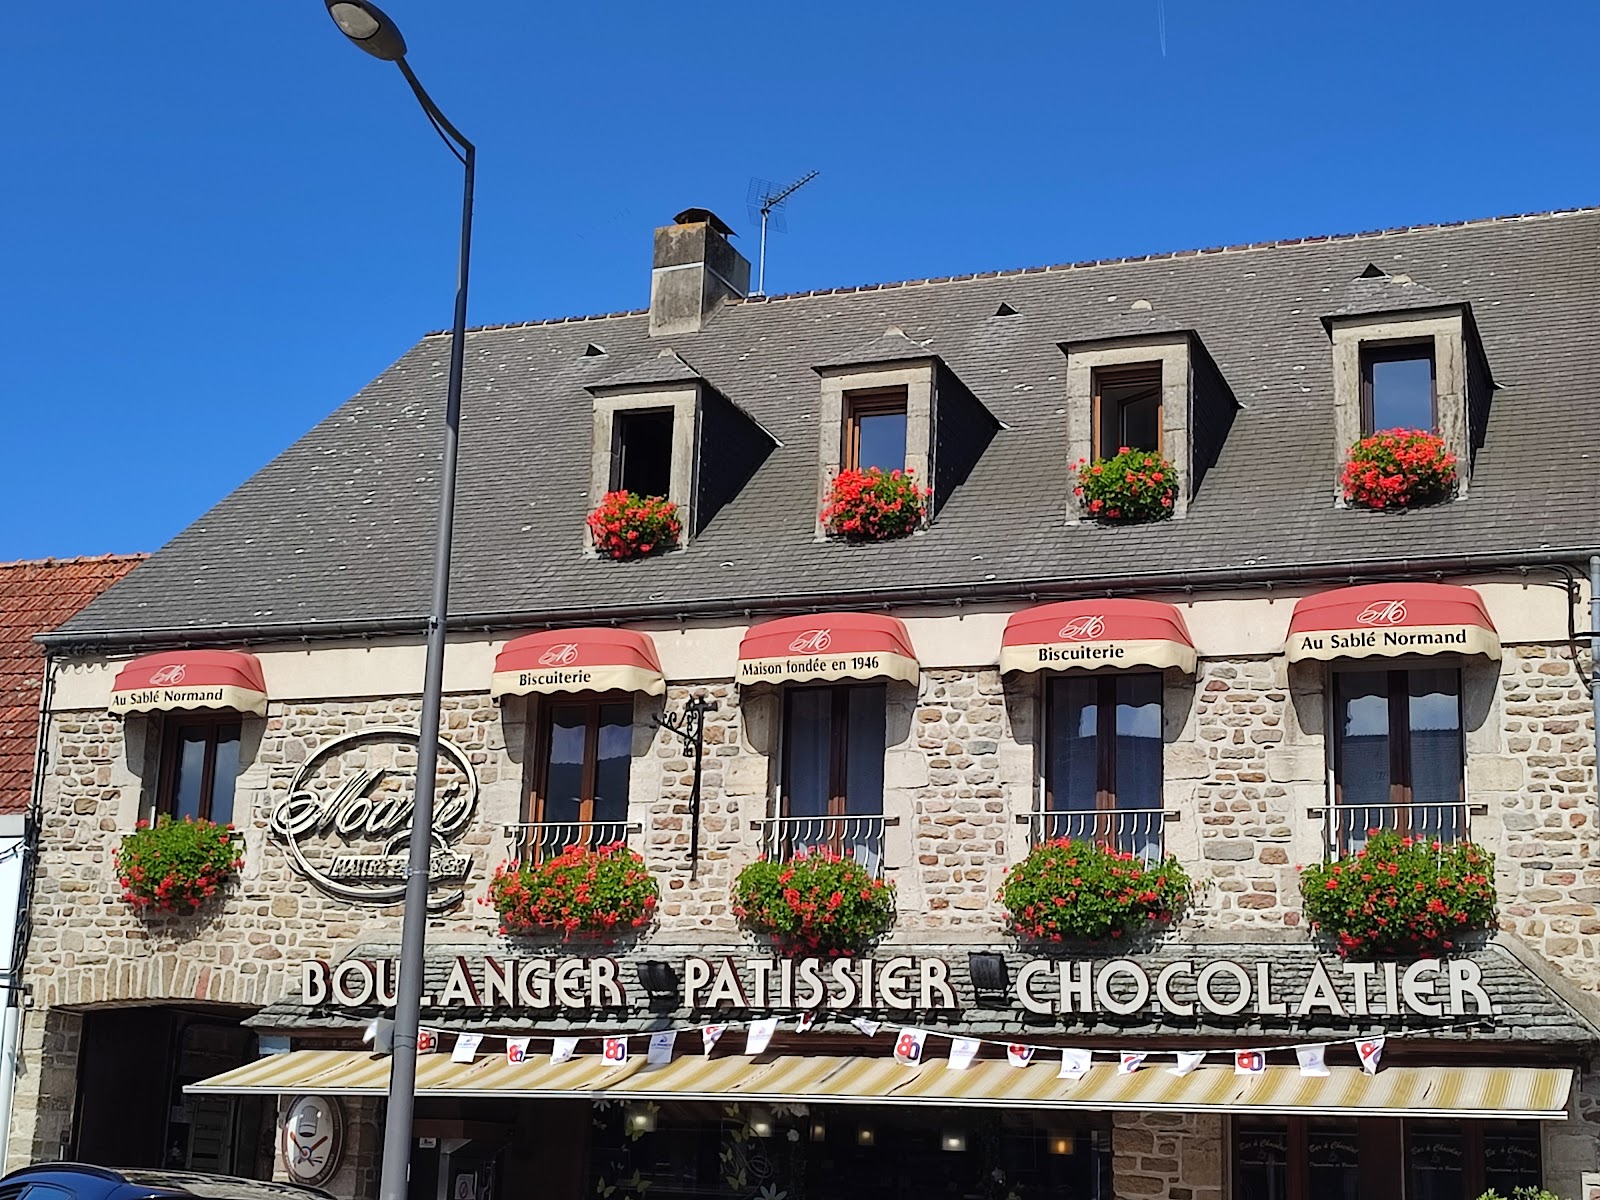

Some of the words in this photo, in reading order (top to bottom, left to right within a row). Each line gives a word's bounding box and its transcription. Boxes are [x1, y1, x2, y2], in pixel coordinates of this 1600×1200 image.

[1301, 636, 1324, 651] Au
[1330, 631, 1376, 649] Sablé
[1383, 628, 1467, 646] Normand
[1038, 643, 1125, 662] Biscuiterie
[742, 661, 782, 676] Maison
[786, 657, 827, 674] fondée
[831, 660, 847, 671] en
[851, 655, 879, 670] 1946
[519, 669, 591, 686] Biscuiterie
[112, 695, 127, 706] Au
[130, 690, 160, 705] Sablé
[164, 688, 224, 702] Normand
[302, 958, 622, 1009] BOUANGER
[684, 957, 956, 1010] PATISSIER
[1016, 958, 1492, 1017] CHOCOLATIER
[605, 1037, 626, 1061] 80
[897, 1033, 921, 1061] 80
